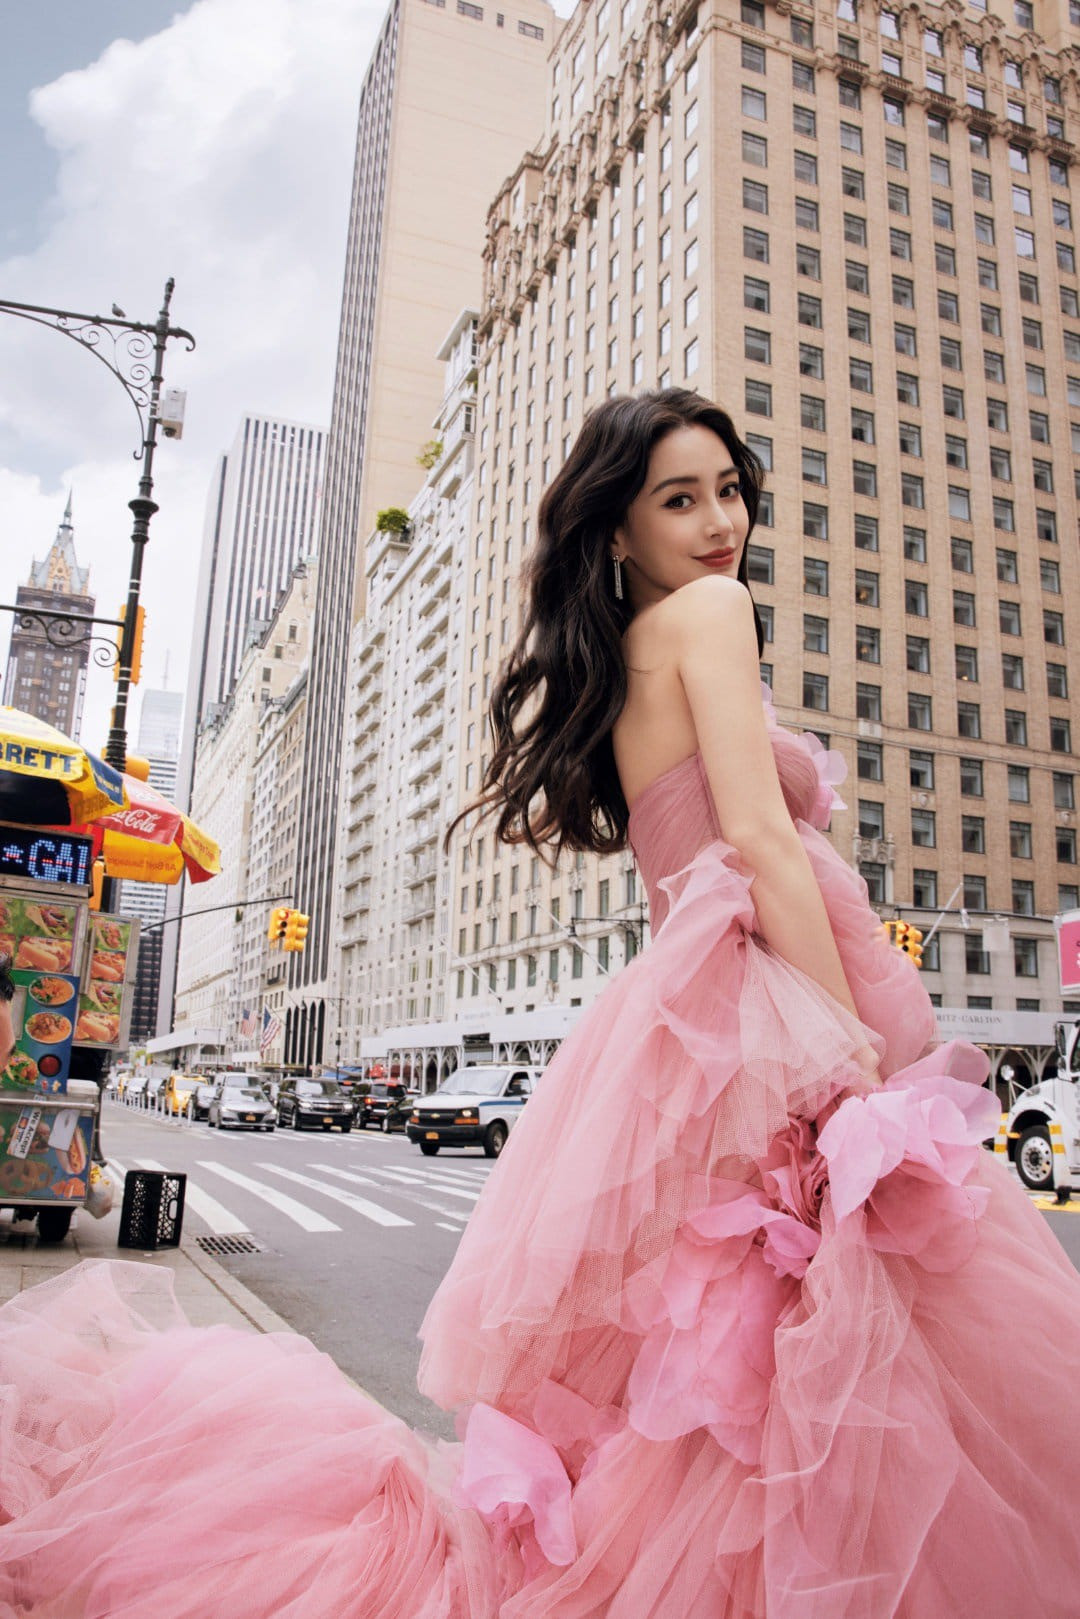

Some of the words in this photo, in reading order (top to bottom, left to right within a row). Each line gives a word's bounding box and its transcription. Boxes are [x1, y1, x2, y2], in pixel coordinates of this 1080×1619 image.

[0, 741, 77, 773] RETT
[31, 1111, 41, 1125] We
[19, 1126, 35, 1154] Accept
